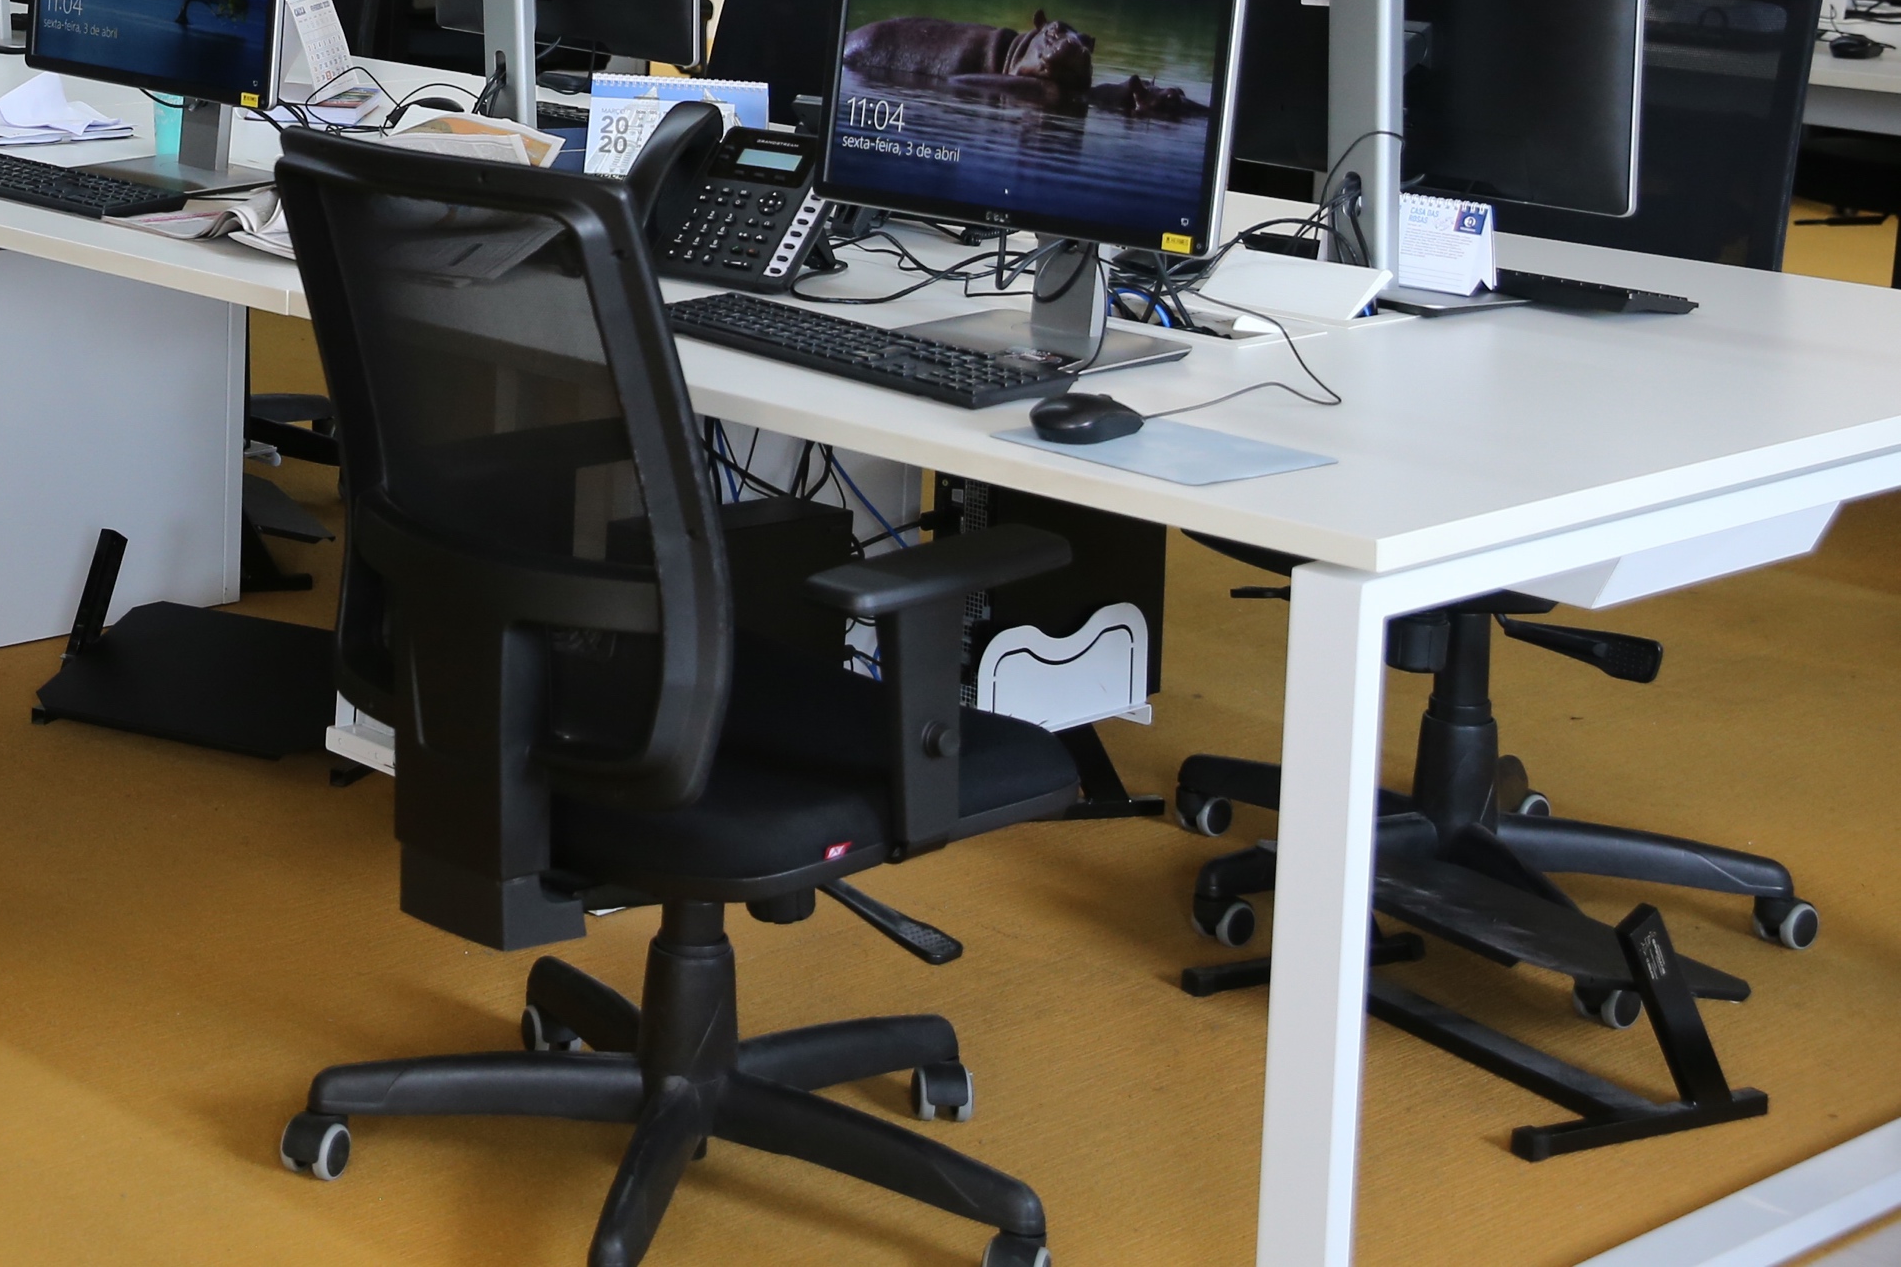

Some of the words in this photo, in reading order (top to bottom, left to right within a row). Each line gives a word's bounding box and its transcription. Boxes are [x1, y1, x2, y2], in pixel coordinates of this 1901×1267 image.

[43, 18, 82, 34] sexta-feira,
[83, 23, 88, 34] 3
[90, 24, 100, 36] de
[101, 26, 118, 39] abril
[600, 115, 628, 134] 20
[847, 97, 905, 132] 11:04
[599, 135, 627, 153] 20
[842, 135, 902, 156] sexta-feira,
[905, 141, 913, 156] 3
[916, 143, 931, 158] de
[934, 145, 960, 162] abril
[1410, 206, 1425, 215] CASA
[1427, 209, 1439, 217] DAS
